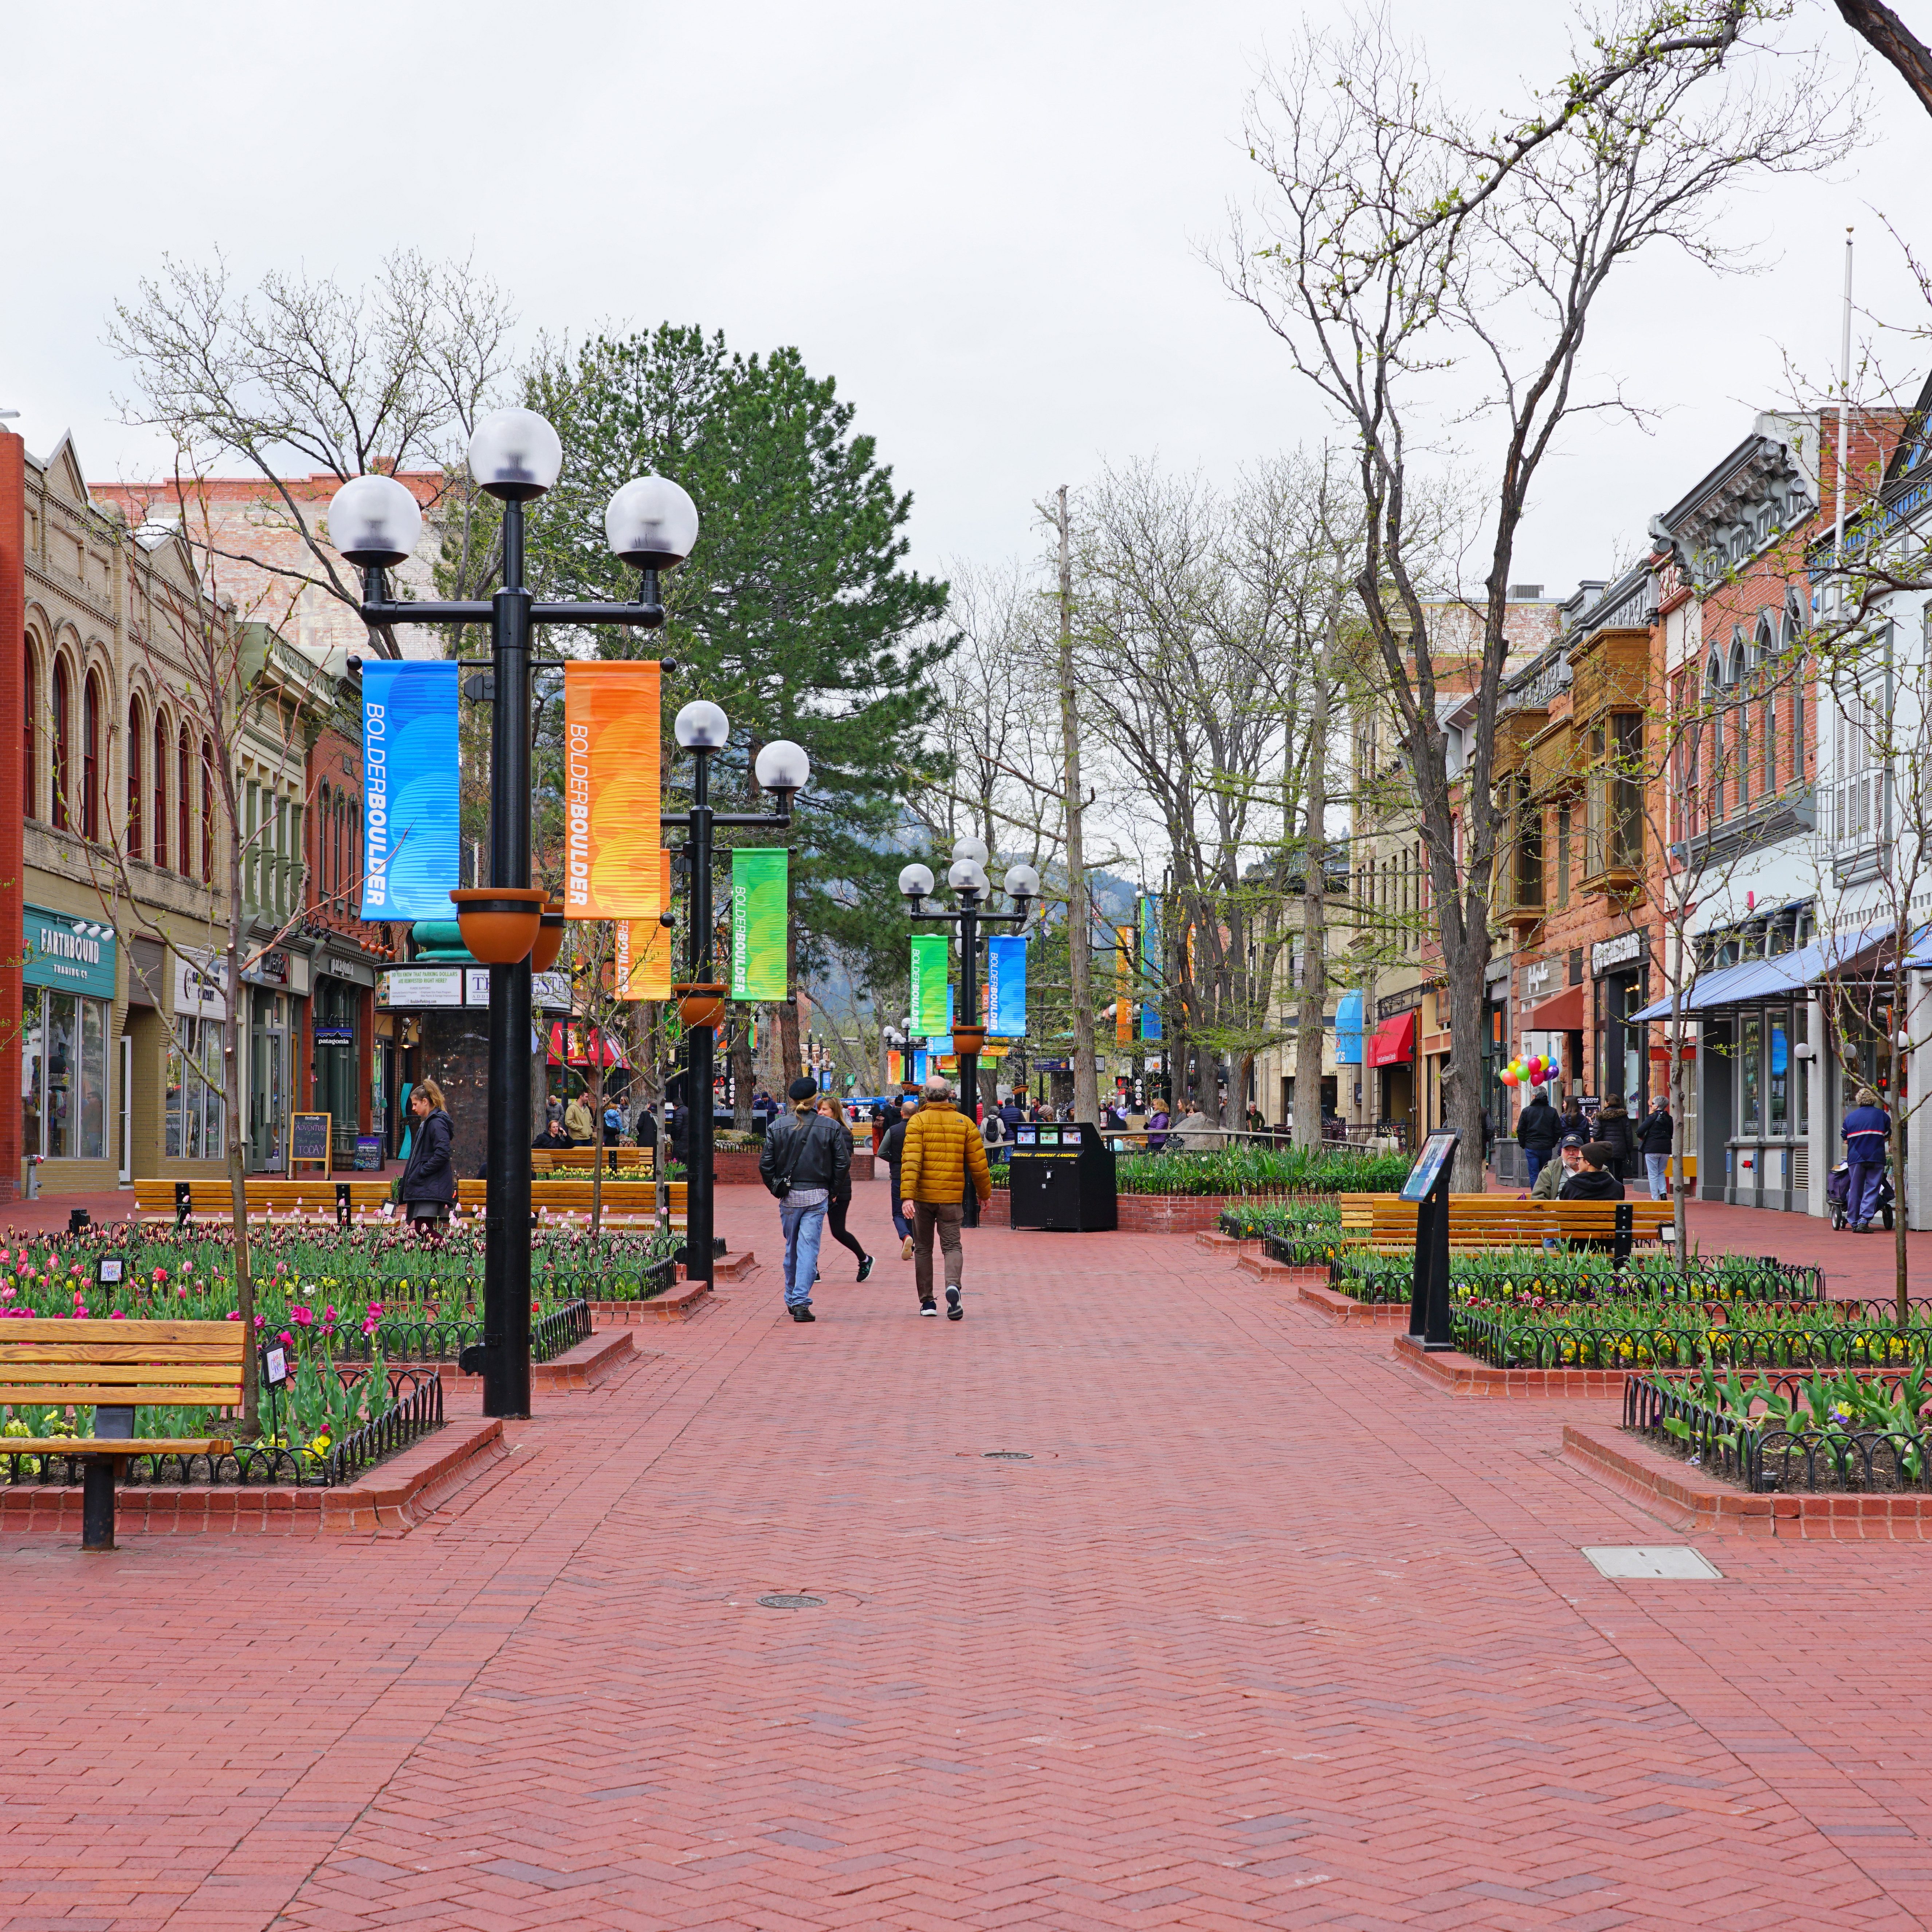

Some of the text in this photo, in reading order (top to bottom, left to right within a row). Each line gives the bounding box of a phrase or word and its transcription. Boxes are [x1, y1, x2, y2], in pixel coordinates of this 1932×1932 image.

[366, 703, 386, 906] BOLDERBOULDER
[570, 724, 588, 906] BOLDERBOULDER
[41, 928, 99, 964] EARTHBOUND
[618, 920, 628, 992] ERBOULDER
[734, 886, 746, 993] BOLDERBOULDER
[1596, 933, 1640, 967] VOLCOM
[54, 964, 79, 977] TRADING
[331, 958, 354, 976] patagonia
[198, 987, 214, 1002] CMPANY
[911, 949, 920, 1029] BOLDERBOULDER
[720, 1077, 724, 1085] 5
[297, 1144, 325, 1154] TODAY
